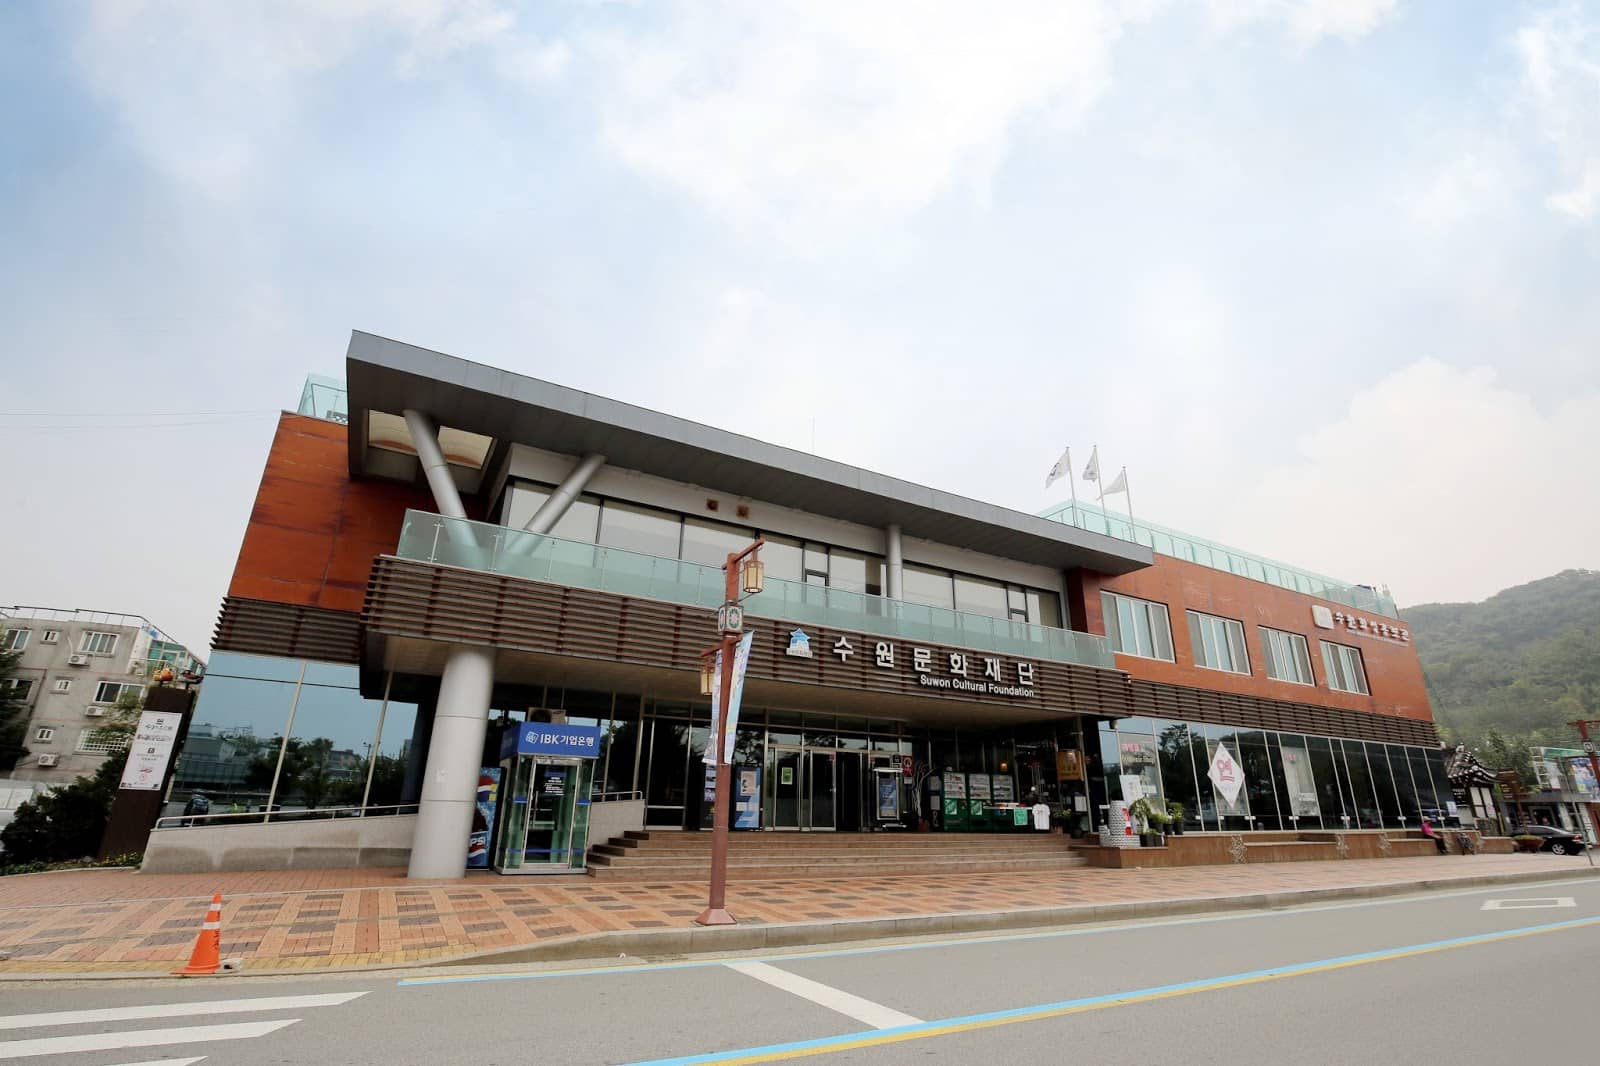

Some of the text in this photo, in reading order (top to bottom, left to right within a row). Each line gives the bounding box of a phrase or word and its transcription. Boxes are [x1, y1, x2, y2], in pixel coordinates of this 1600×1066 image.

[833, 636, 1034, 686] 수원문화재단
[920, 674, 1035, 697] Suwon Cultural Foundation
